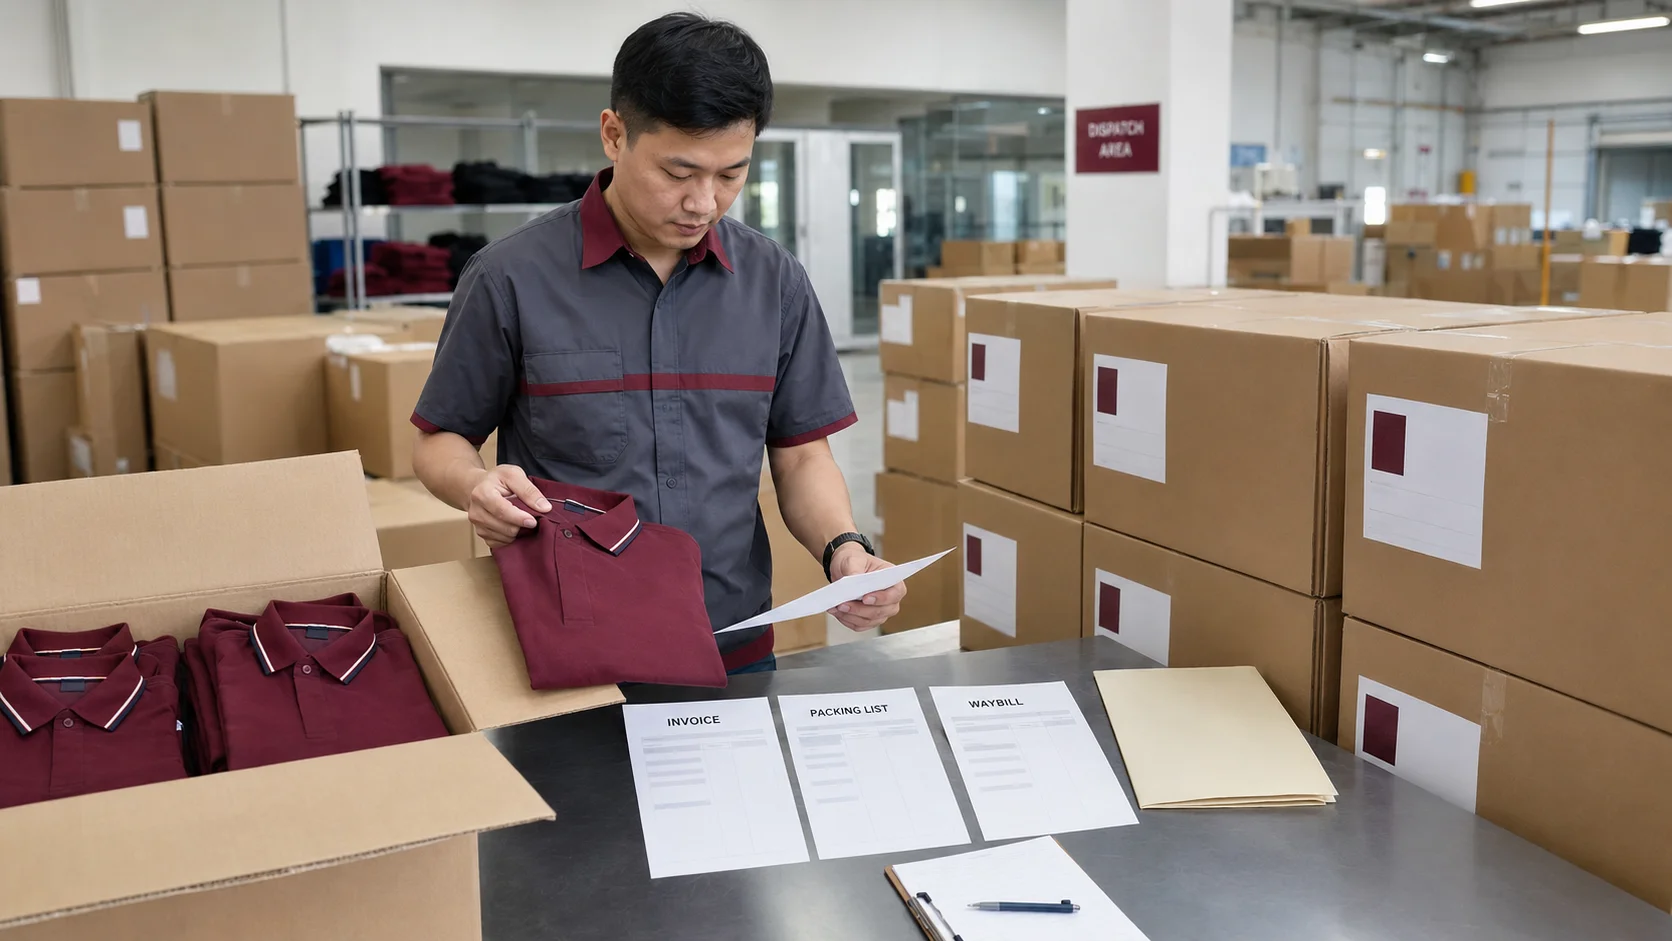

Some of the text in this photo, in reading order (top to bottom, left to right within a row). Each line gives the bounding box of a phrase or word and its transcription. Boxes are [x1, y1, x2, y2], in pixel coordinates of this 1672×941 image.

[1088, 120, 1144, 137] DISPATCH
[1099, 142, 1132, 158] AREA
[968, 698, 1024, 709] WAYBILL
[810, 704, 888, 718] PACKING LIST
[667, 715, 721, 727] INVOICE
